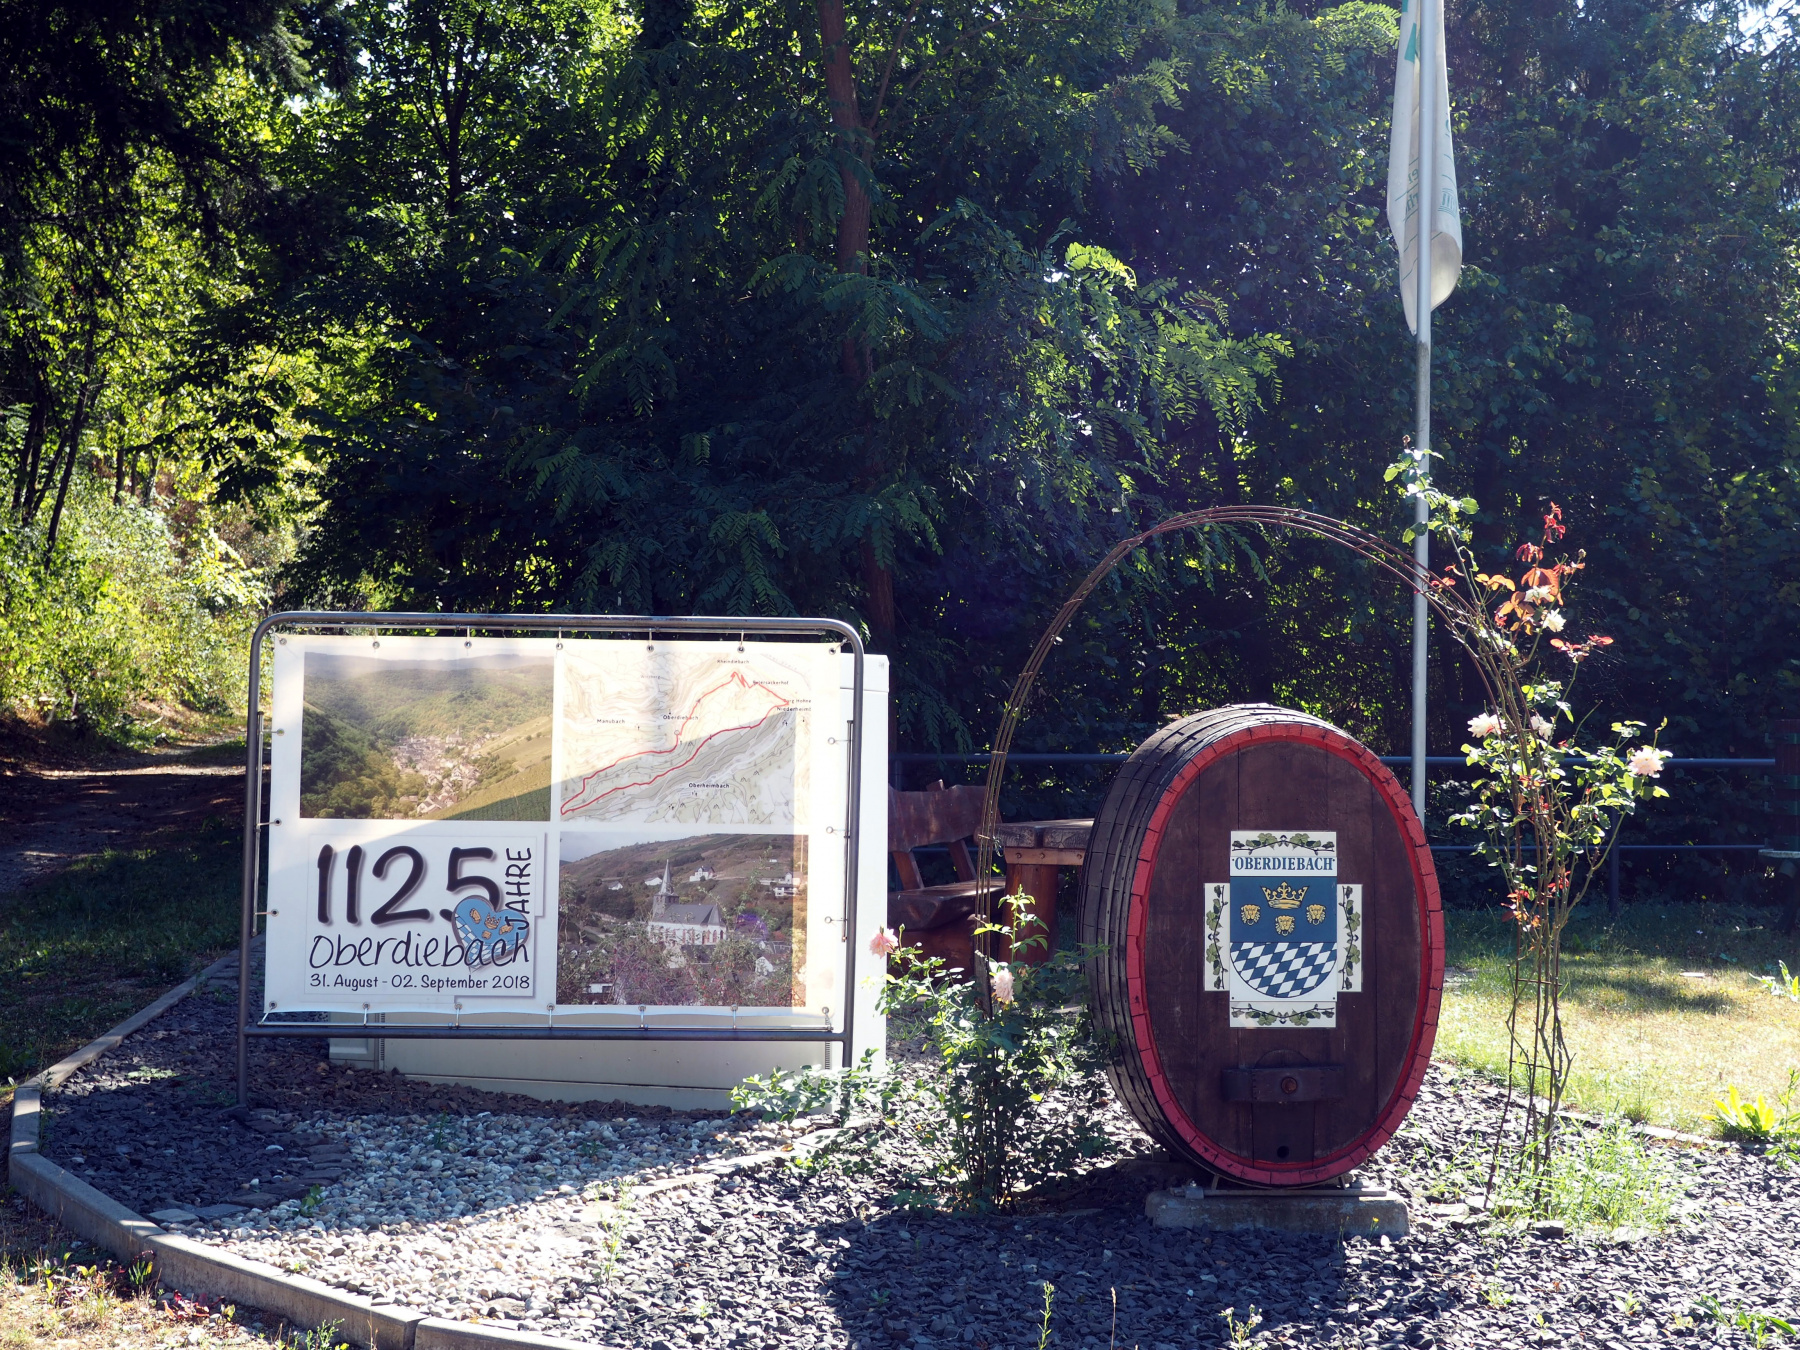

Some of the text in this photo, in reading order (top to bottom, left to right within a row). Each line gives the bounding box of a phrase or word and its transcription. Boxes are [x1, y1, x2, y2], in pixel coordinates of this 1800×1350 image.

[1234, 856, 1333, 871] OBERDIEBACH
[317, 843, 502, 925] 1125
[505, 847, 532, 931] JAHRE
[309, 930, 530, 969] Oberdiebach
[310, 973, 330, 988] 31.
[333, 973, 379, 991] August
[391, 974, 417, 989] 02.
[421, 974, 489, 992] September
[492, 975, 530, 989] 2018
